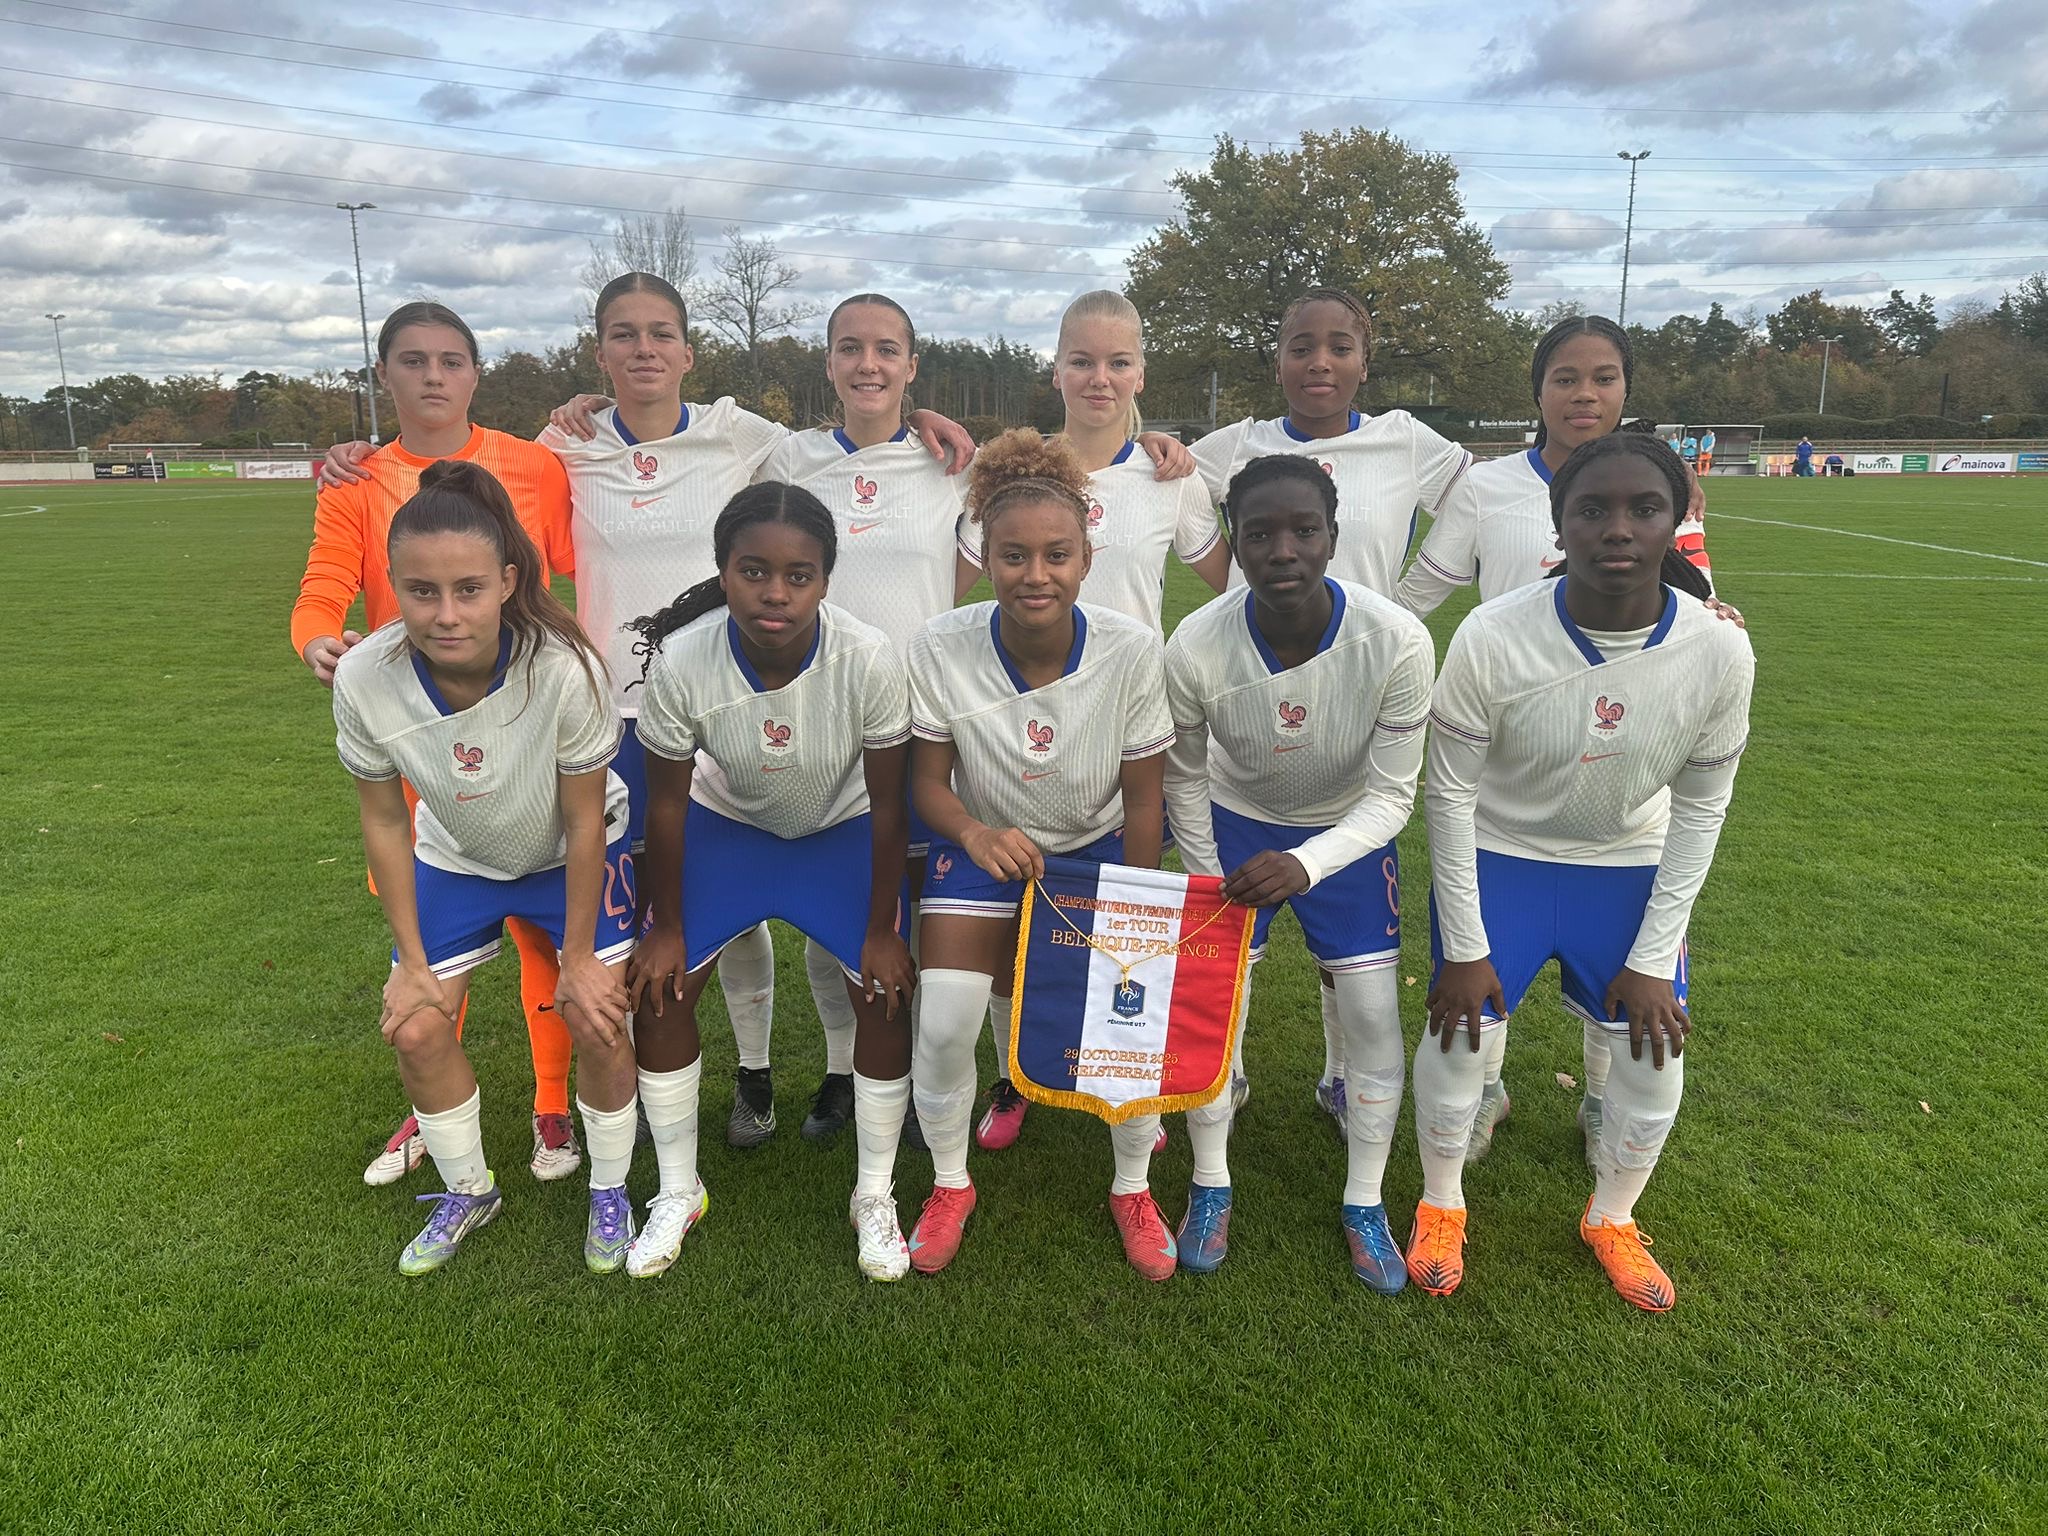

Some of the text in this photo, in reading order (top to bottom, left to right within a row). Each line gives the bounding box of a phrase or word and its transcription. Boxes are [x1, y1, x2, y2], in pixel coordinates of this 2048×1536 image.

[1857, 461, 1894, 469] hurlin
[1961, 460, 2006, 469] mainova
[602, 519, 696, 535] CATAPULT
[604, 853, 636, 917] 20
[1382, 856, 1399, 917] 8
[1106, 918, 1169, 934] 1er TOUR
[1051, 929, 1219, 959] BELGIQUE-FRANCE
[1064, 1048, 1179, 1064] 29 OCTOBRE 2025
[1067, 1065, 1173, 1081] KELSTERBACH
